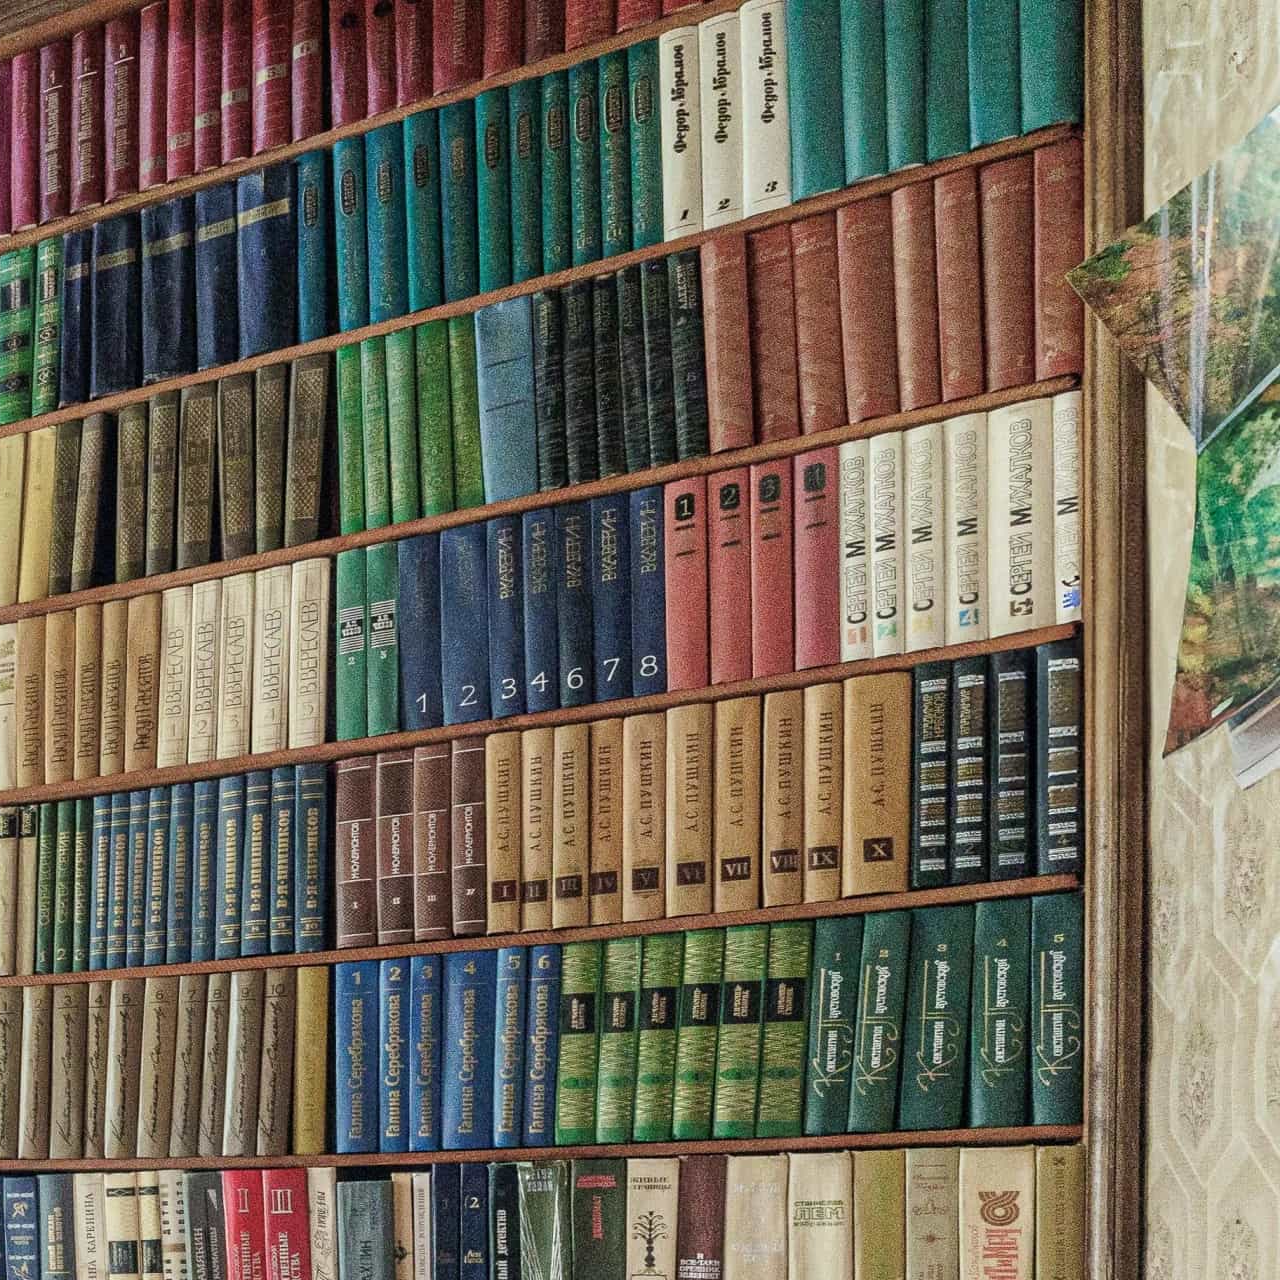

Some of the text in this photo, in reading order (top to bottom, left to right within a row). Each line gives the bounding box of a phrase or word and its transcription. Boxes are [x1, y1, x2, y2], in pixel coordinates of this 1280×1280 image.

[764, 180, 779, 193] 3
[680, 207, 691, 221] 1
[716, 197, 732, 210] 2
[678, 498, 692, 517] 1
[955, 430, 979, 604] СЕРГЕЙ МИХАЛКОВ
[1007, 418, 1033, 595] СЕРГЕЙ МИХАЛКОВ
[874, 448, 897, 620] СЕРГЕЙ МИХАЛКОВ
[910, 438, 934, 612] СЕРГЕЙ МИХАЛКОВ
[844, 455, 867, 624] СЕРГЕЙ МИХАЛКОВ
[602, 657, 621, 682] 7
[639, 654, 658, 677] 8
[500, 677, 517, 700] 3
[530, 670, 549, 693] 4
[566, 666, 584, 690] 6
[415, 692, 427, 713] 1
[459, 684, 478, 707] 2
[811, 850, 837, 868] IX
[869, 842, 888, 858] X
[724, 860, 749, 877] VII
[1053, 933, 1065, 943] 5
[463, 959, 478, 975] 4
[505, 953, 521, 969] 5
[538, 953, 551, 969] 6
[351, 969, 361, 985] 1
[389, 966, 402, 981] 2
[347, 997, 367, 1139] Галина Серебрякова
[384, 993, 405, 1137] Галина Серебрякова
[458, 987, 479, 1133] Галина Серебрякова
[498, 983, 521, 1133] Галина Серебрякова
[528, 984, 553, 1134] Галина Серебрякова
[469, 1196, 481, 1210] 2
[793, 1206, 845, 1221] ЛЕМ
[83, 1191, 98, 1254] КАРЕНИНА
[495, 1209, 509, 1257] ДЕТЕКТИВ
